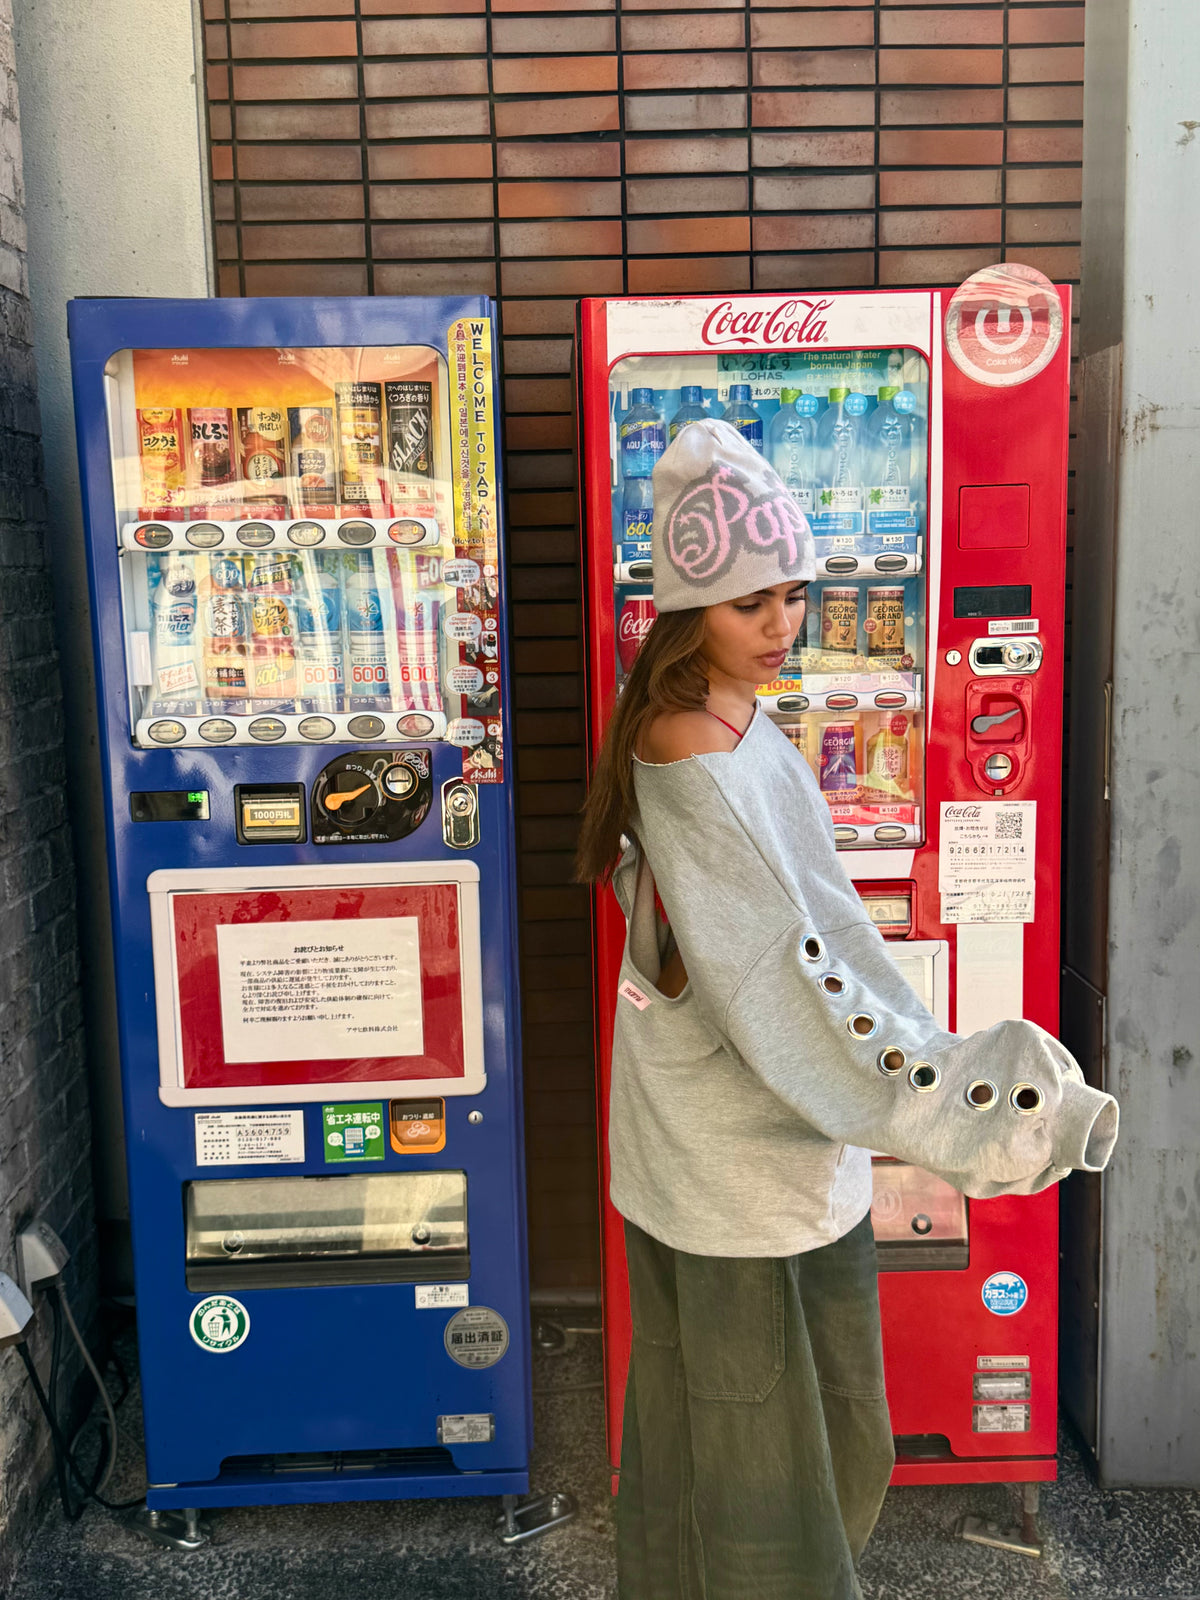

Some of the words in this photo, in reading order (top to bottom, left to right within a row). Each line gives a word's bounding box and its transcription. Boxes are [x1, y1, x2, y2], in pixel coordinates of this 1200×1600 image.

[702, 299, 834, 346] Coca-Cola
[803, 354, 820, 362] The
[470, 322, 486, 422] WELCOME
[741, 371, 783, 381] LOHAS
[387, 393, 430, 403] くつろぎの香り
[143, 435, 177, 448] コクうま
[475, 432, 486, 454] TO
[476, 462, 490, 530] JAPAN
[353, 666, 385, 683] 600
[470, 768, 497, 780] Asahi
[294, 945, 344, 954] お詫びとお知らせ
